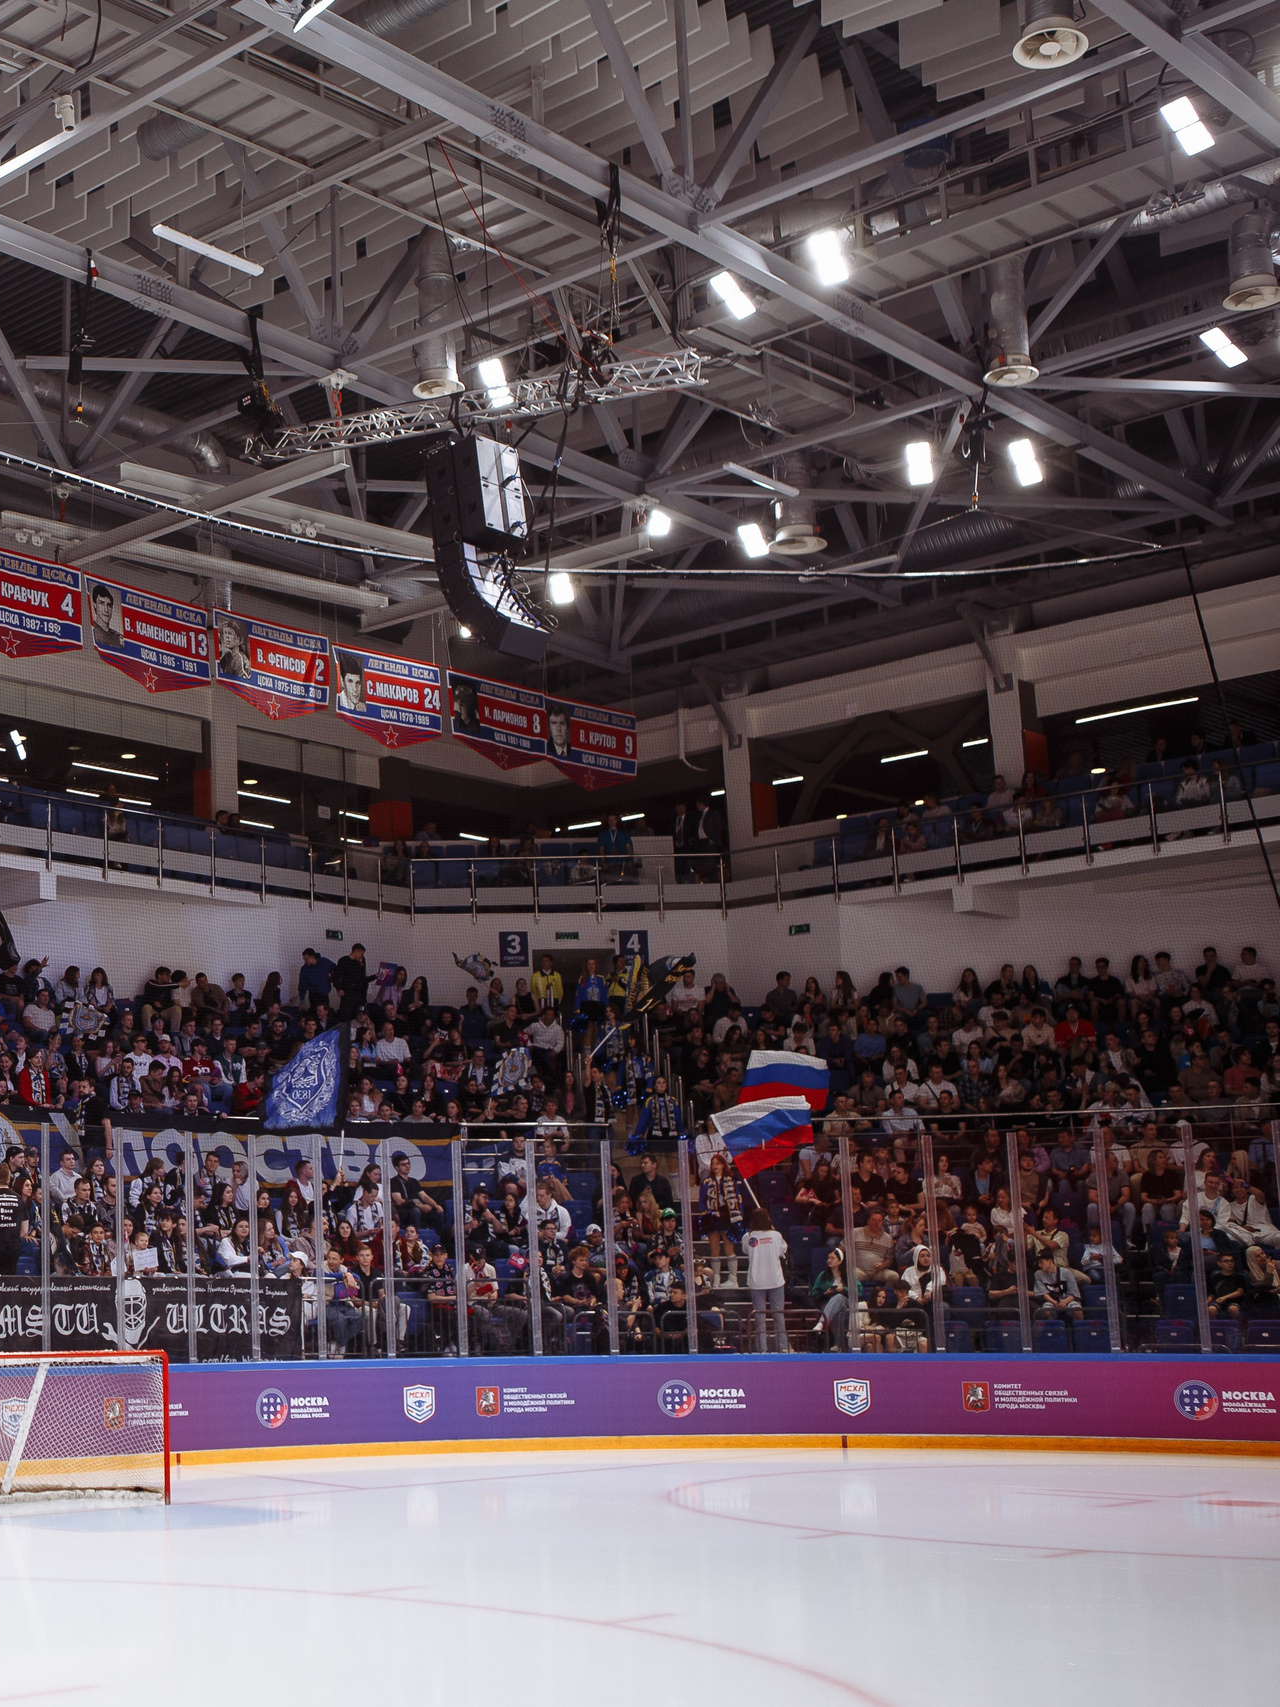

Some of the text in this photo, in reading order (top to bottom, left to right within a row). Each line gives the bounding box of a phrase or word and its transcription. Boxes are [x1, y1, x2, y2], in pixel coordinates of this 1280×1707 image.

[42, 567, 74, 584] ЦСКА
[1, 581, 50, 608] КРАВЧУК
[61, 593, 74, 617] 4
[126, 592, 202, 624] ЛЕГЕНДЫ ЦСКА
[0, 611, 61, 635] ЦСКА 1987-1992
[125, 618, 187, 648] В. КАМЕНСКИЙ
[189, 632, 208, 656] 13
[251, 624, 322, 649] ЛЕГЕНДЫ ЦСКА
[141, 648, 157, 661] ЦСКА
[159, 654, 175, 666] 1985
[182, 659, 197, 672] 1991
[257, 649, 306, 674] В. ФЕТИСОВ
[315, 660, 324, 681] 2
[368, 658, 435, 680] ЛЕГЕНДЫ ЦСКА
[257, 675, 273, 688] ЦСКА
[366, 680, 419, 703] С.МАКАРОВ
[424, 688, 441, 710] 24
[480, 683, 540, 704] ЛЕГЕНДЫ ЦСКА
[380, 708, 397, 720] ЦСКА
[493, 709, 527, 728] ЛАРИОНОВ
[533, 714, 540, 733] 8
[573, 707, 632, 727] ЛЕГЕНДЫ ЦСКА
[589, 732, 616, 748] КРУТОВ
[625, 736, 633, 754] 9
[506, 934, 521, 954] 3
[626, 933, 641, 953] 4
[290, 1397, 329, 1406] МОСКВА
[700, 1389, 745, 1398] МОСКВА
